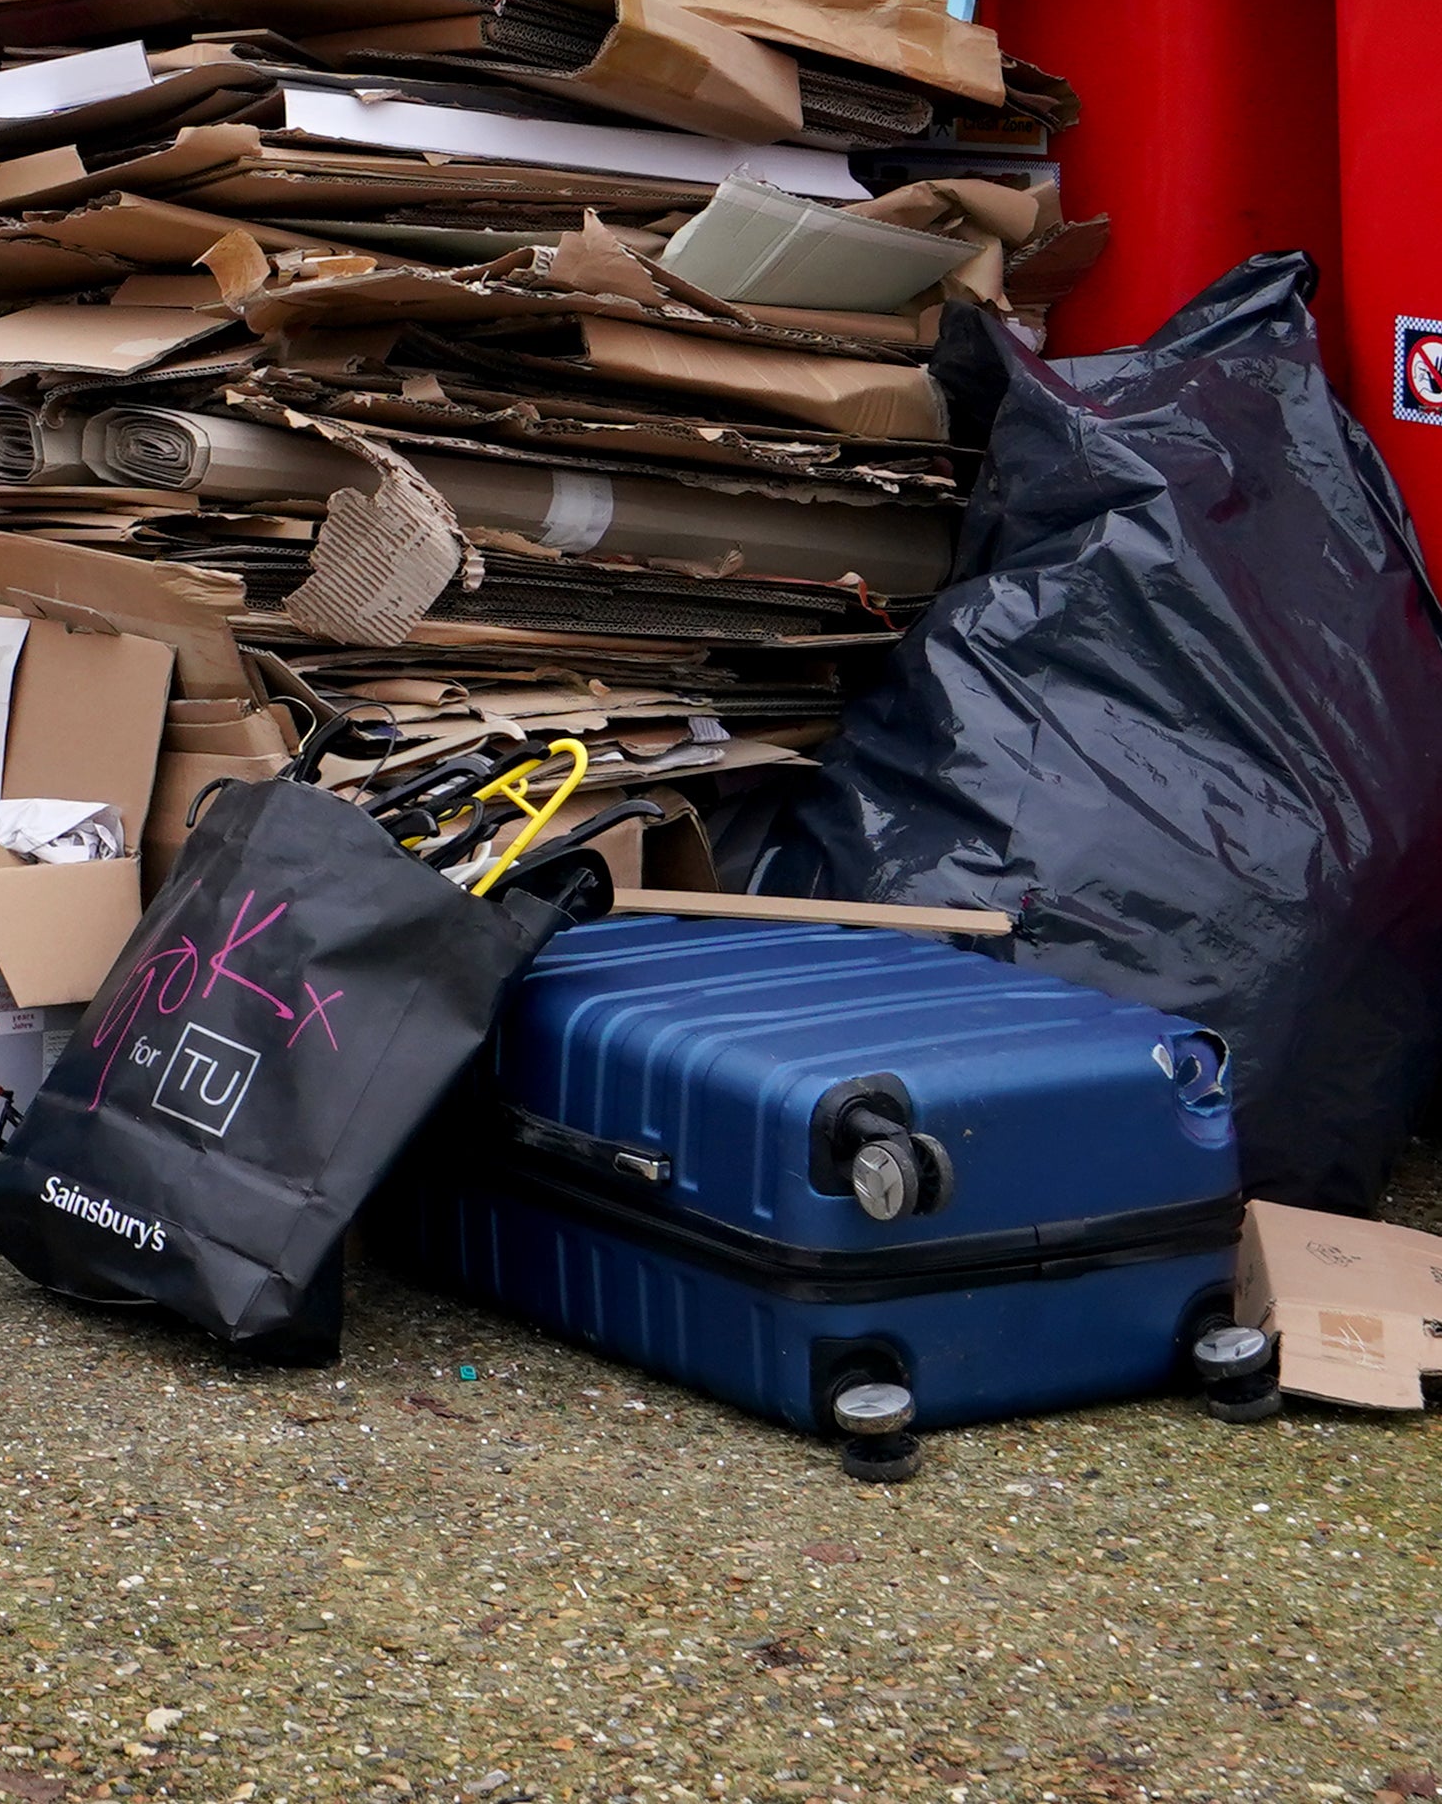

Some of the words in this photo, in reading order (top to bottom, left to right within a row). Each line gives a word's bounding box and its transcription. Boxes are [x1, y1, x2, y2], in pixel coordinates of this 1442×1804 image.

[1002, 117, 1033, 133] Zone
[129, 1035, 162, 1068] for
[180, 1047, 240, 1106] TU
[40, 1175, 168, 1252] Sainsbury's
